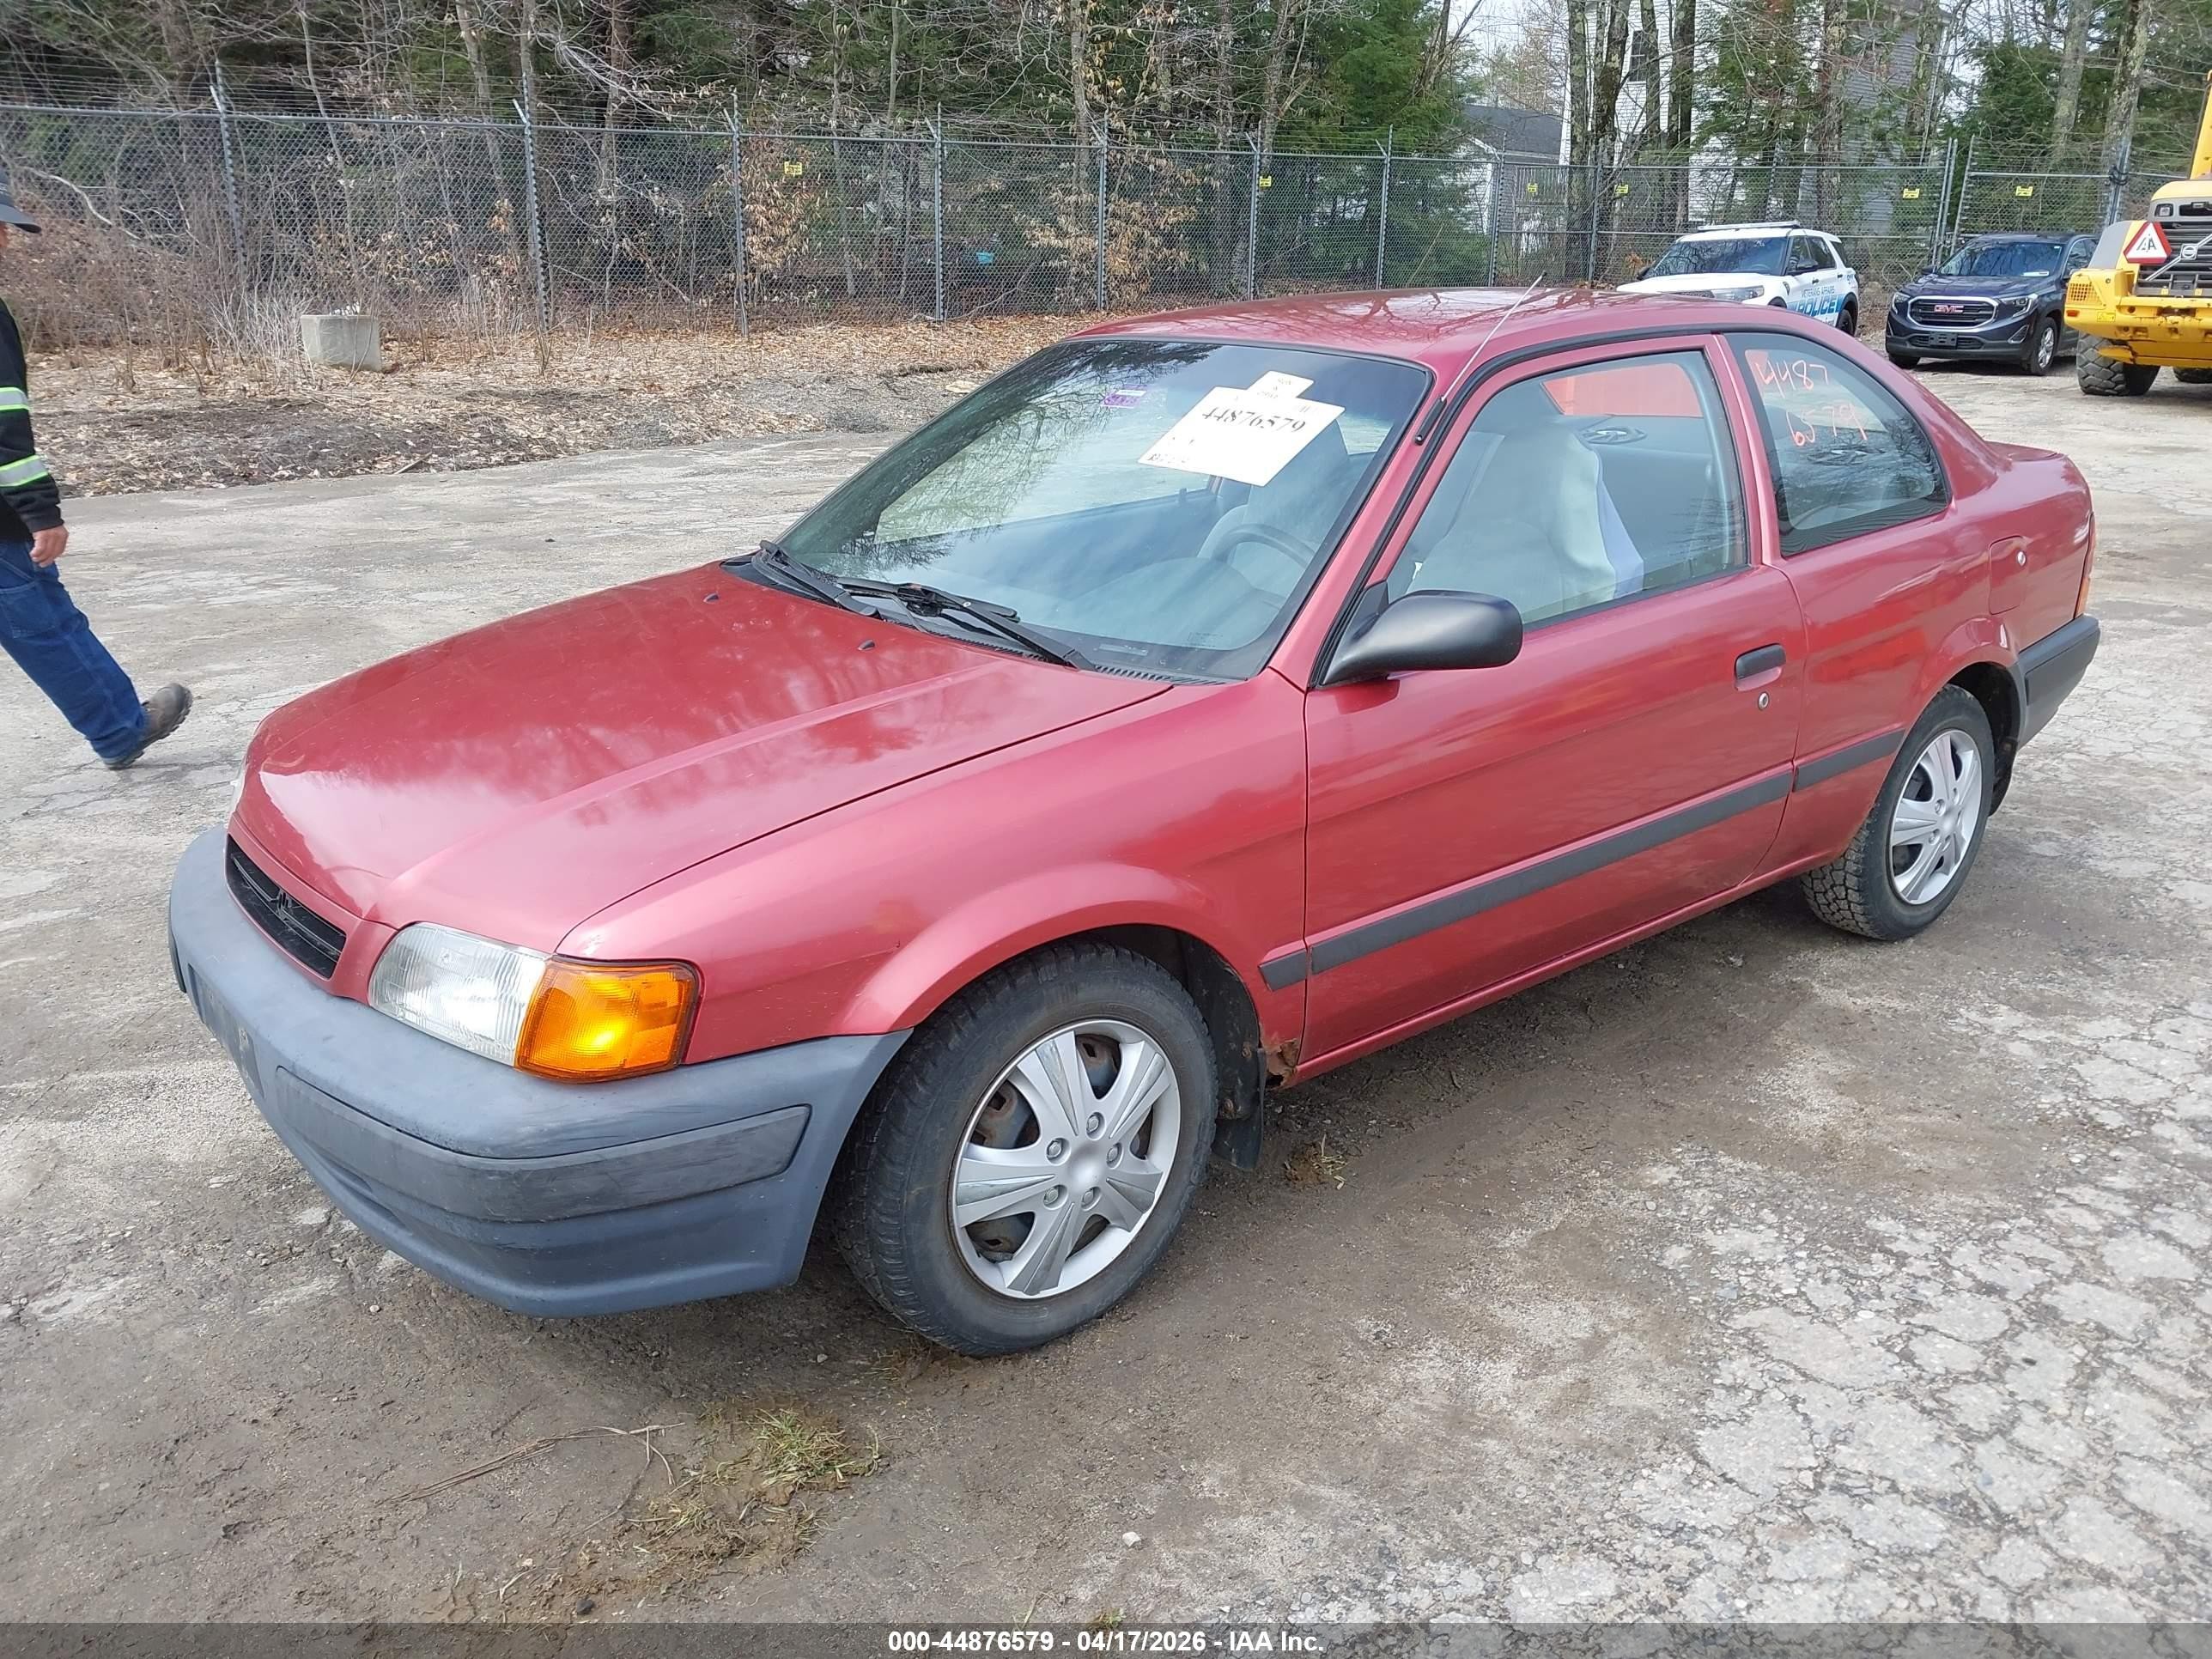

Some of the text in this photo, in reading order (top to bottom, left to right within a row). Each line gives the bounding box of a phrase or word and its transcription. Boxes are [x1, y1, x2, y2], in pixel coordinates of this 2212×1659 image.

[1796, 295, 1838, 317] POLICE
[1934, 305, 1965, 313] GMC
[1755, 359, 1829, 398] 4487
[1201, 406, 1306, 432] 44876579
[1785, 403, 1868, 447] 6579
